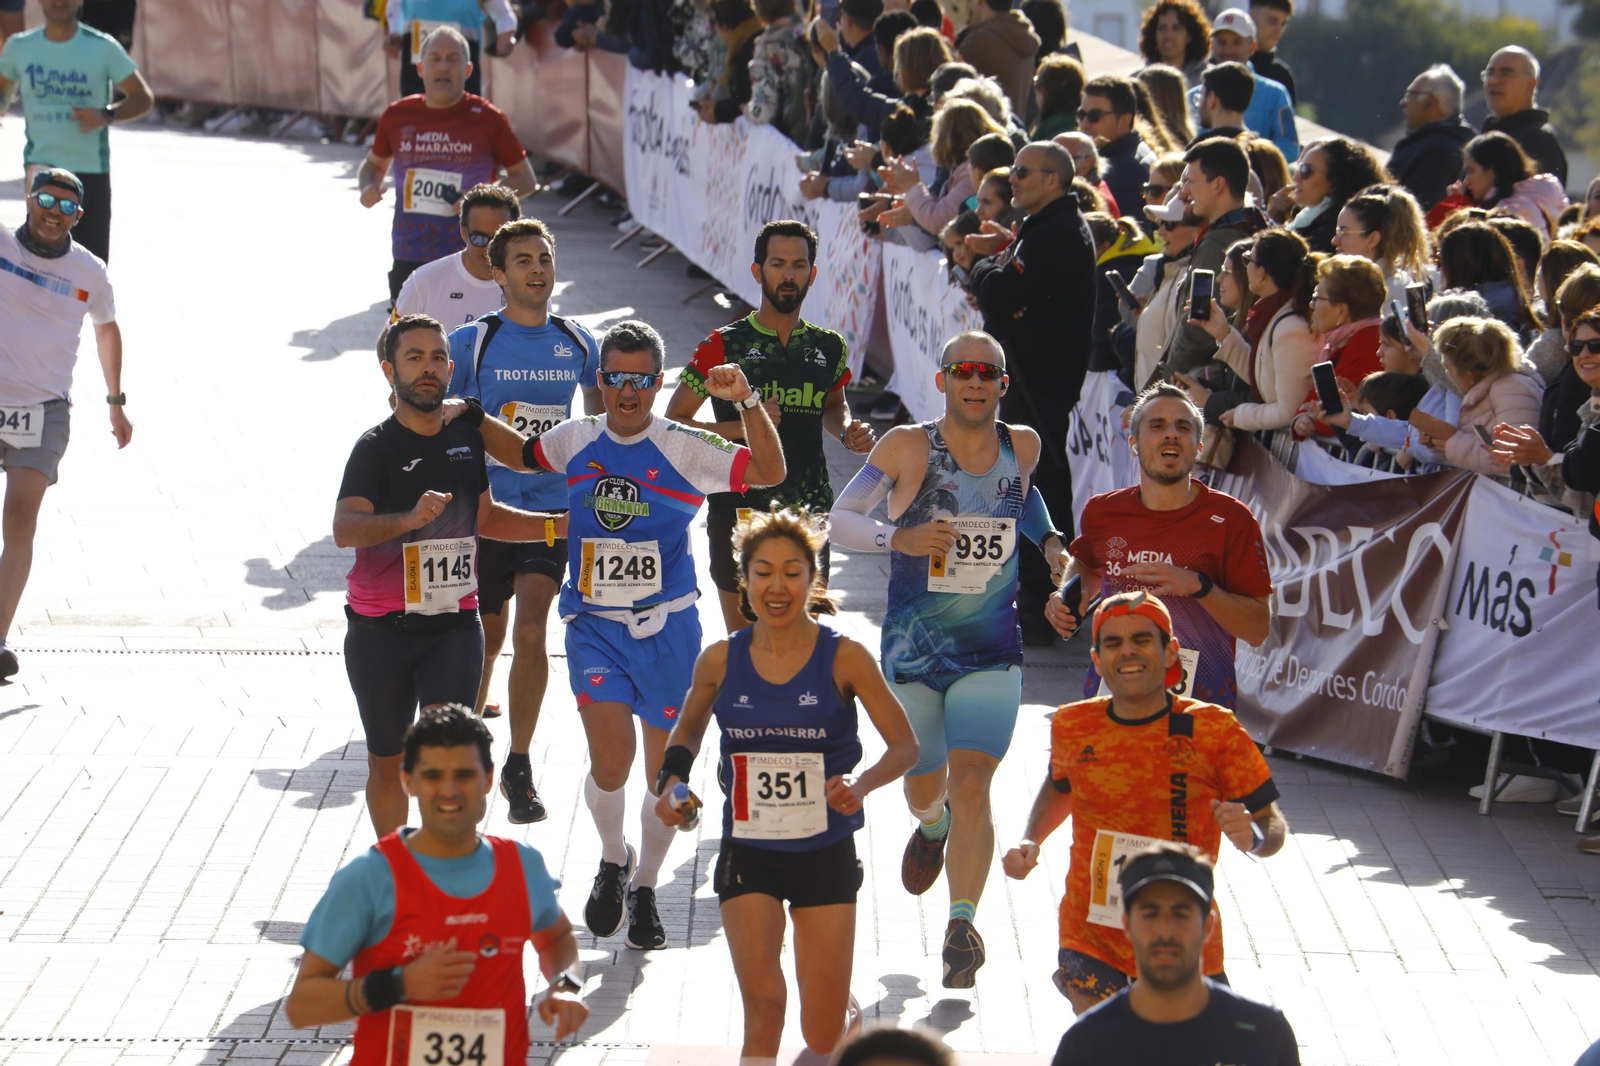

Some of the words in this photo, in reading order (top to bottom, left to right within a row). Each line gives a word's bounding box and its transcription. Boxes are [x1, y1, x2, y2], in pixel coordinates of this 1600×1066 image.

[416, 131, 450, 142] MEDIA
[399, 140, 412, 152] 36
[415, 140, 472, 153] MARATÓN
[494, 369, 577, 381] TROTASIERRA
[525, 405, 550, 414] IMDECO
[608, 477, 625, 486] CLUB
[958, 520, 990, 528] IMDECO
[430, 543, 458, 551] IMDECO
[955, 534, 1003, 560] 935
[1128, 550, 1173, 565] MEDIA
[423, 554, 471, 582] 1145
[595, 555, 656, 580] 1248
[1106, 561, 1121, 576] 36
[583, 564, 591, 587] CAJÓN
[1455, 544, 1536, 637] Más
[1286, 655, 1357, 701] Deportes
[726, 727, 827, 739] TROTASIERRA
[757, 757, 792, 765] IMDECO
[757, 771, 807, 800] 351
[423, 1032, 486, 1066] 334
